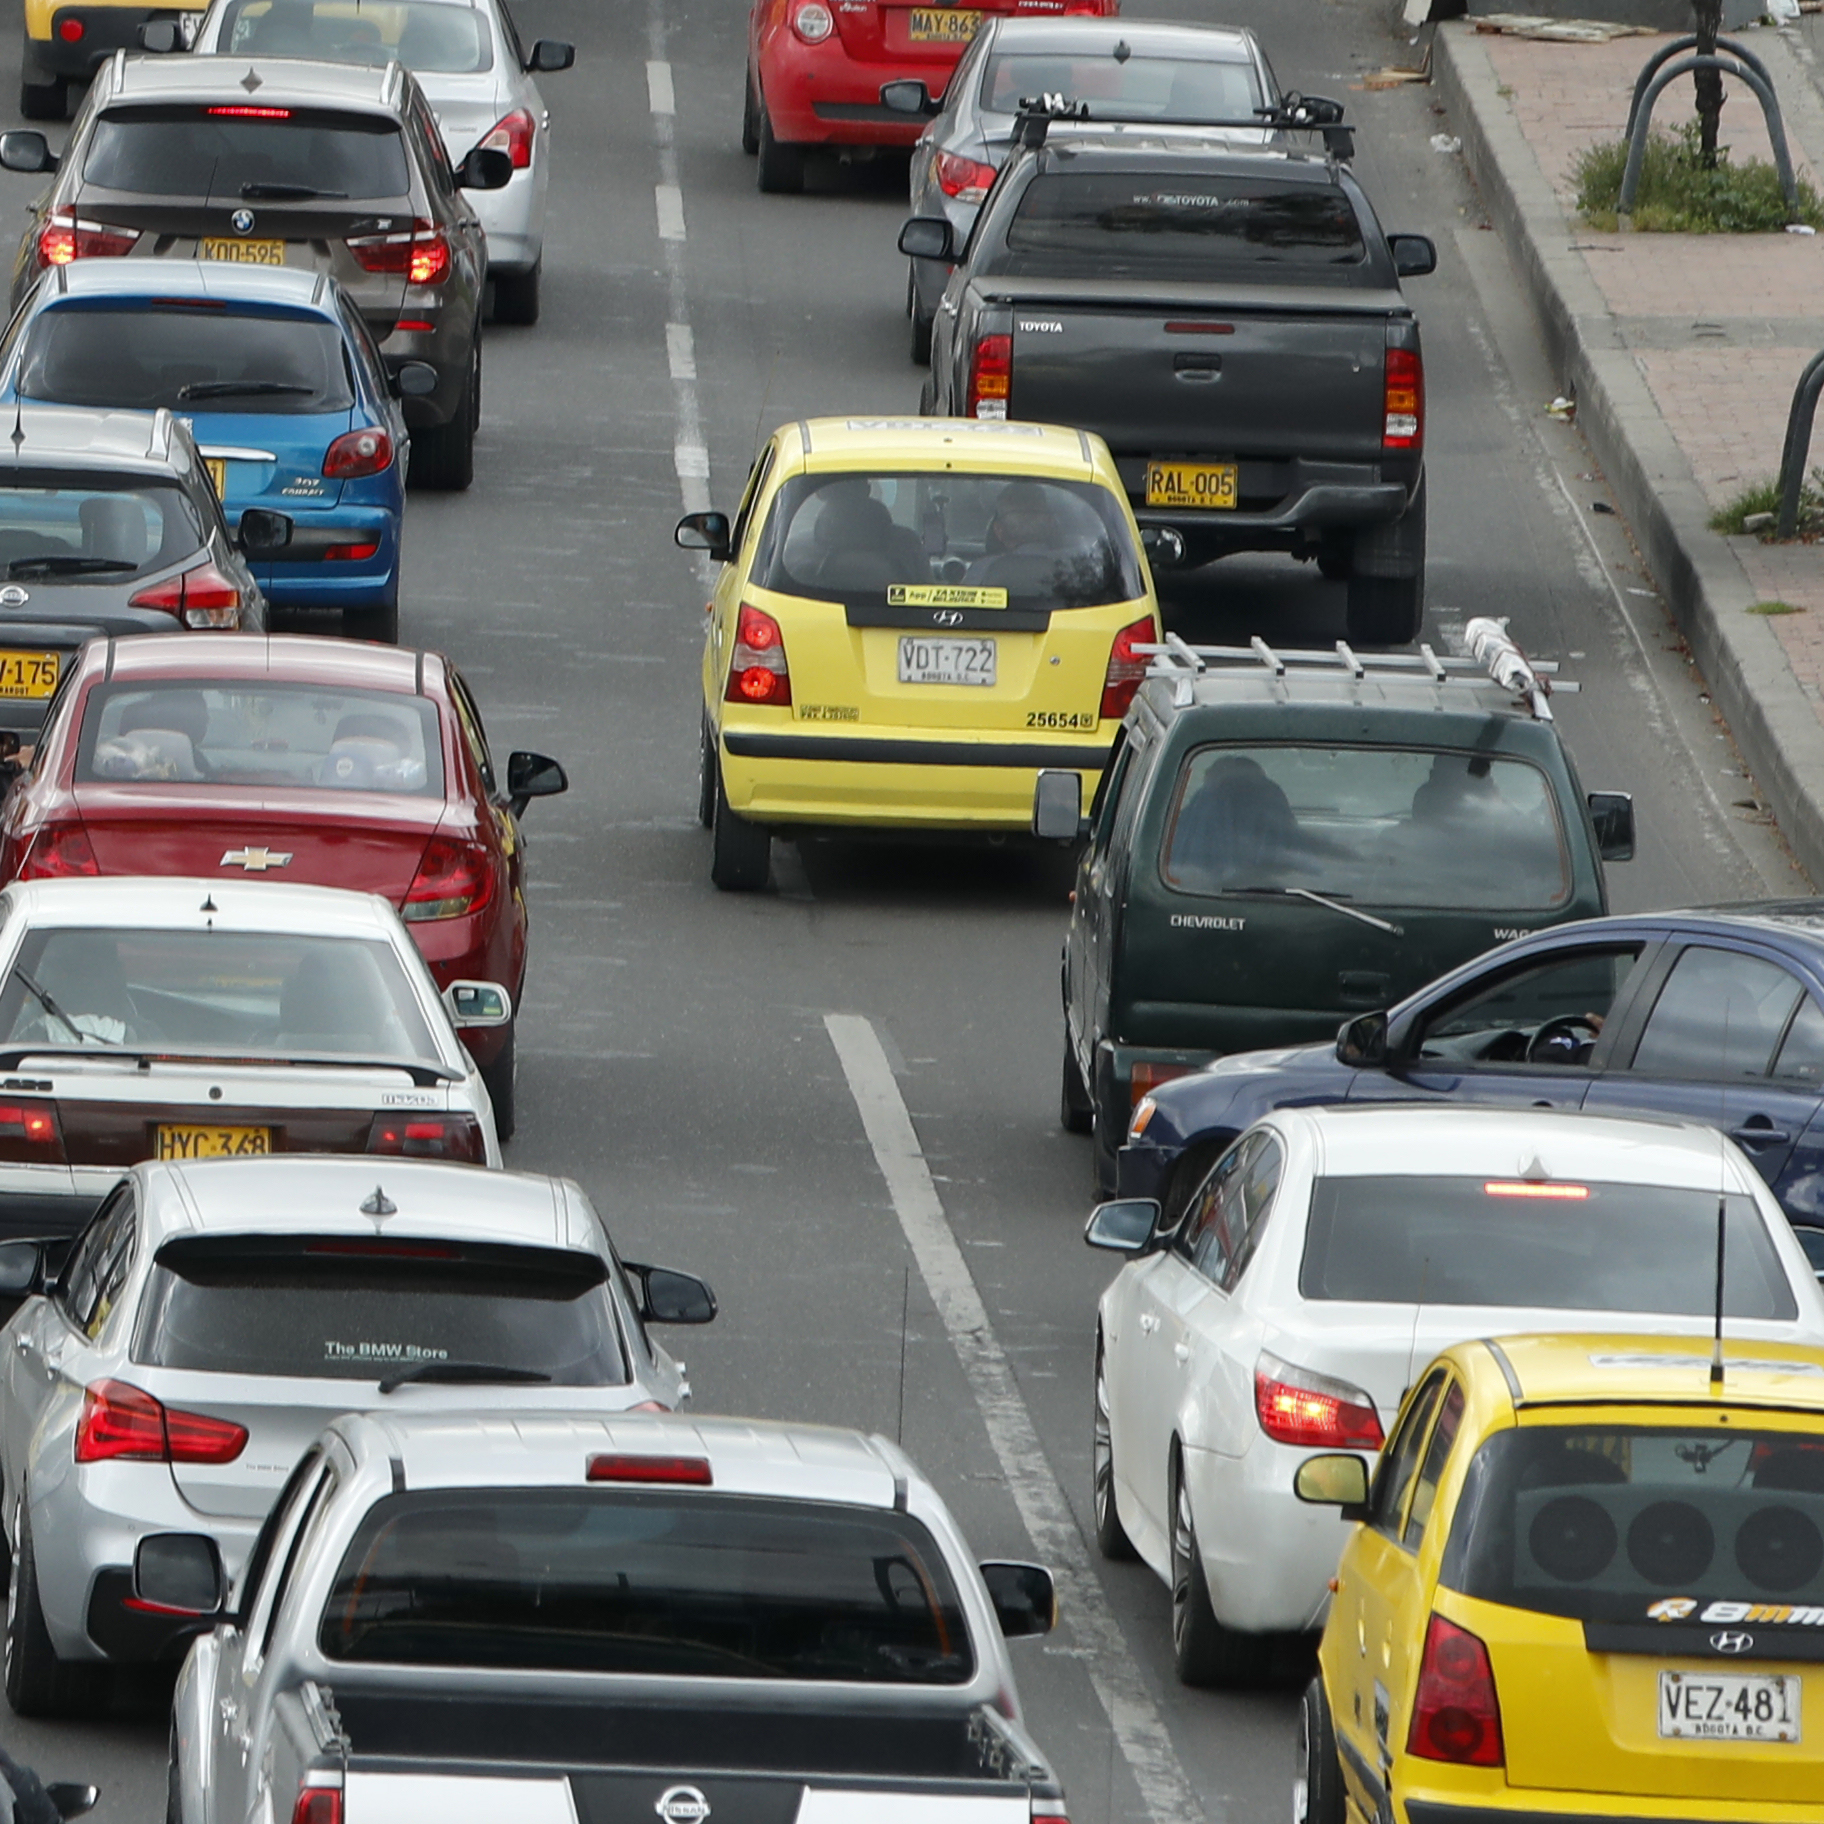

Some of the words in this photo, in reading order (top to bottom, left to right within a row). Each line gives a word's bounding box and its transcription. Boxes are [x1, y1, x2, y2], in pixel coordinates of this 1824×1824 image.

[1019, 321, 1063, 333] TOYOTA
[1026, 712, 1077, 729] 25654
[1169, 913, 1247, 931] CHEVROLET
[325, 1342, 355, 1355] The
[358, 1343, 403, 1357] BMW
[405, 1344, 449, 1359] Store
